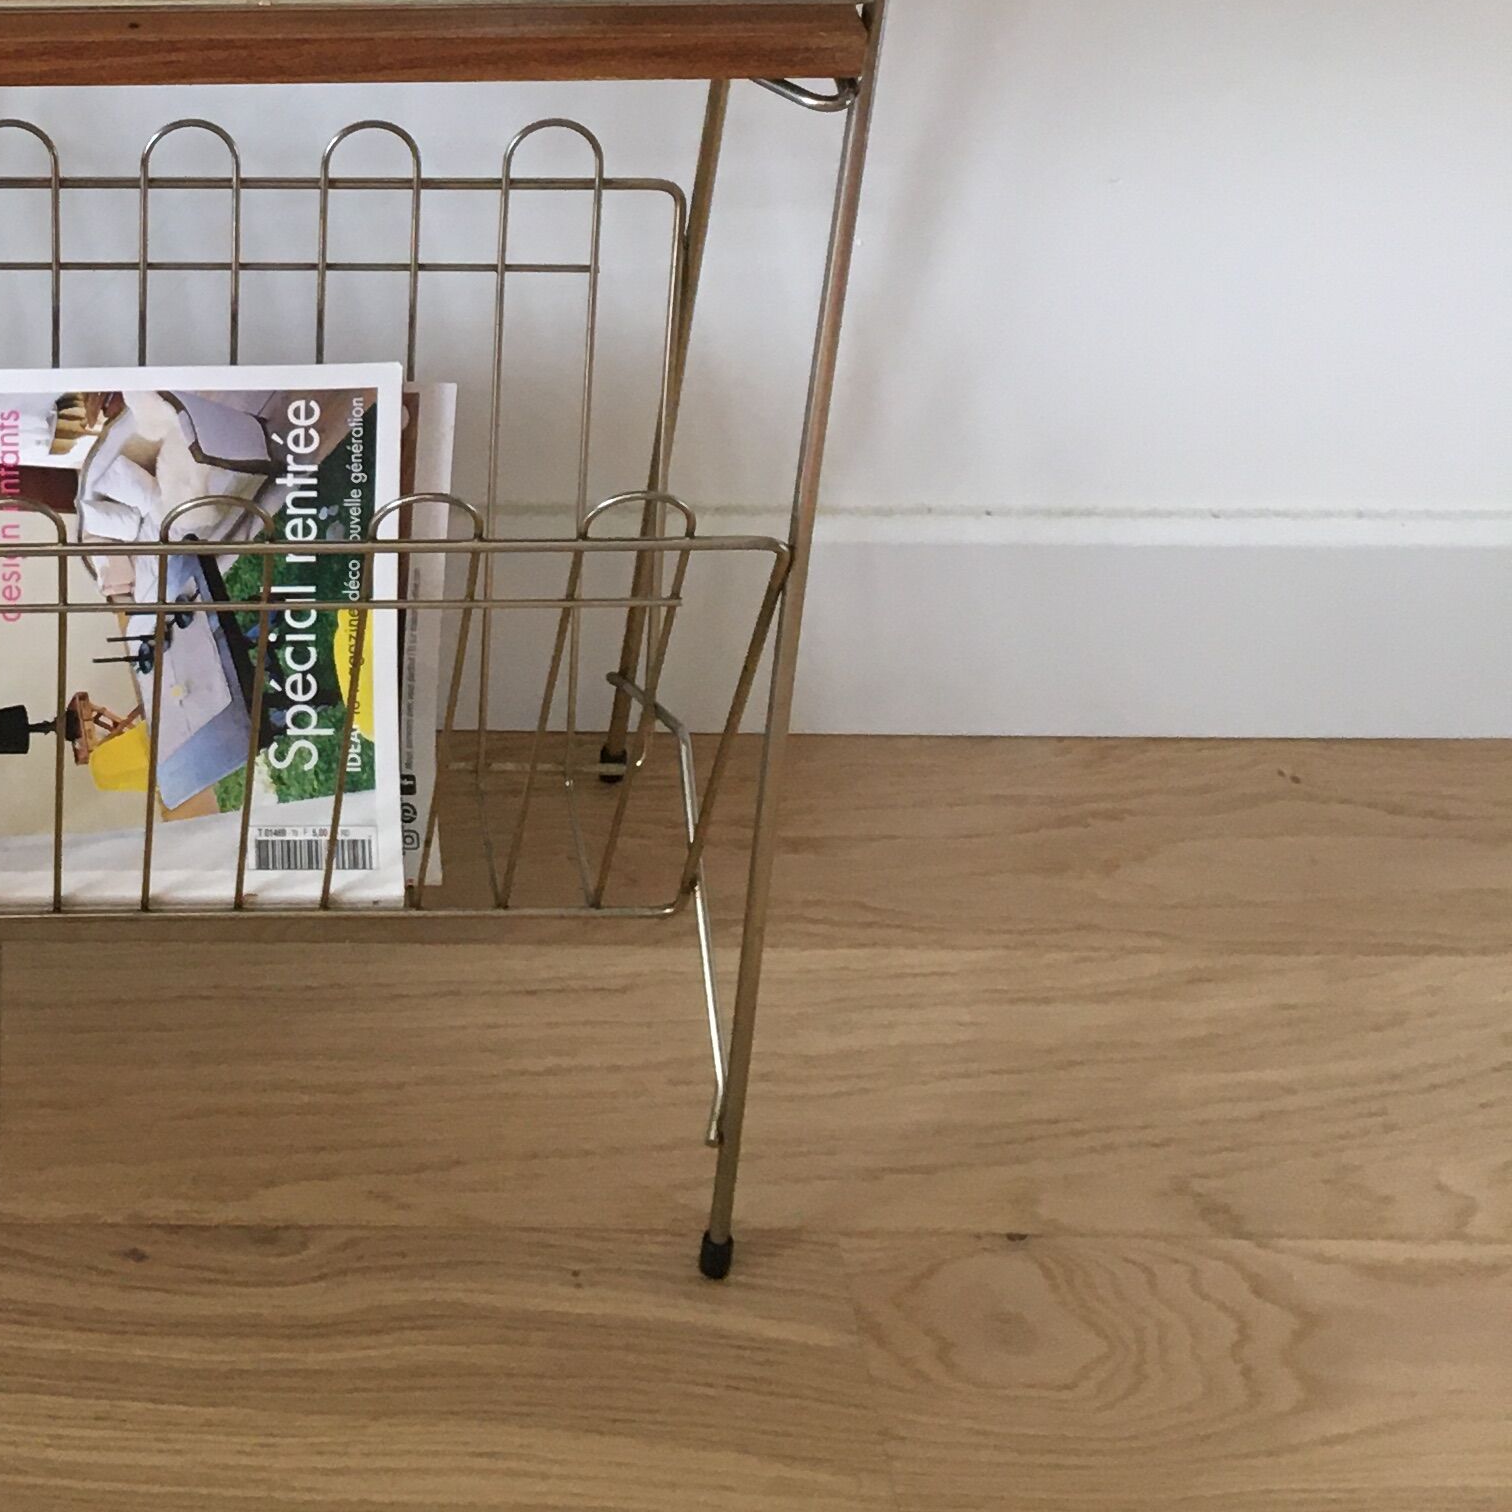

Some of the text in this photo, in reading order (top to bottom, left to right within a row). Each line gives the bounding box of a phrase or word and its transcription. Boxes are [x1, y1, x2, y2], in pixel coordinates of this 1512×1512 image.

[345, 397, 368, 483] génération
[343, 489, 361, 540] ouvelle
[262, 400, 335, 771] Spécial rentrée
[342, 560, 361, 601] déco
